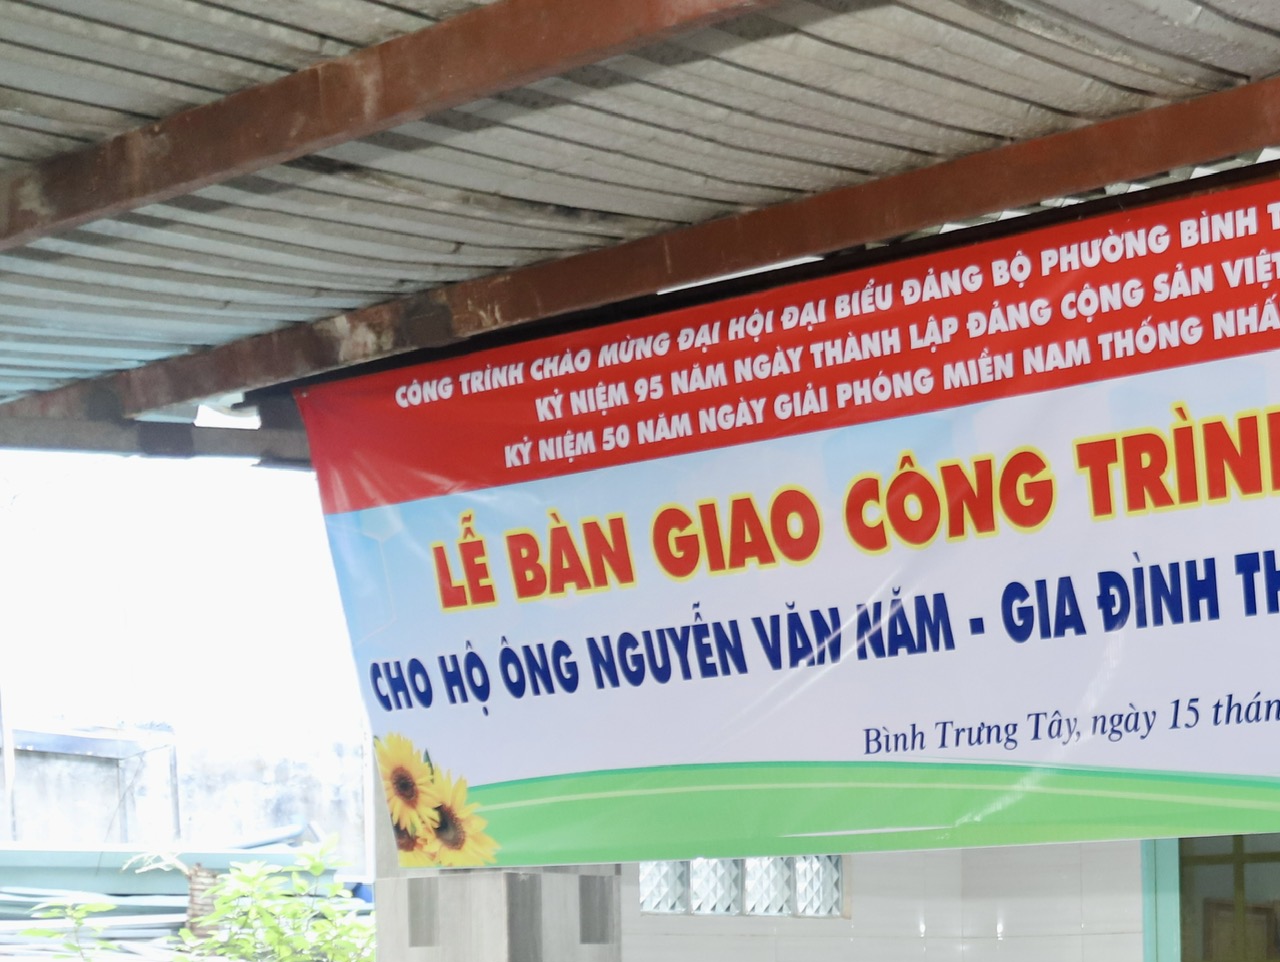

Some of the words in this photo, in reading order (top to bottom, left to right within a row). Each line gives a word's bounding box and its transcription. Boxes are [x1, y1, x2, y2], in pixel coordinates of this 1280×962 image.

[395, 377, 454, 408] CÔNG
[459, 363, 525, 395] TRÌNH
[530, 349, 592, 381] CHÀO
[597, 332, 670, 368] MỪNG
[677, 322, 720, 358] ĐẠI
[728, 310, 773, 343] HỘI
[781, 299, 827, 336] ĐẠI
[834, 278, 893, 319] BIỂU
[901, 265, 983, 306] ĐẢNG
[991, 250, 1032, 288] BỘ
[1040, 224, 1170, 277] PHƯỜNG
[1180, 204, 1258, 248] BÌNH
[535, 390, 564, 423] KỶ
[569, 380, 629, 416] NIỆM
[634, 375, 664, 401] 95
[670, 362, 727, 397] NĂM
[733, 343, 803, 383] NGÀY
[810, 326, 901, 368] THÀNH
[909, 316, 958, 355] LẬP
[966, 300, 1052, 339] ĐẢNG
[1061, 281, 1145, 323] CỘNG
[1153, 263, 1214, 303] SẢN
[504, 436, 532, 469] KỶ
[538, 427, 596, 463] NIỆM
[602, 426, 630, 452] 50
[637, 409, 692, 445] NĂM
[699, 393, 767, 432] NGÀY
[773, 380, 828, 422] GIẢI
[837, 364, 935, 409] PHÓNG
[943, 347, 1014, 390] MIỀN
[1022, 338, 1091, 376] NAM
[1098, 317, 1203, 361] THỐNG
[431, 513, 496, 610] LỄ
[505, 510, 635, 601] BÀN
[651, 488, 822, 580] GIAO
[844, 454, 1056, 553] CÔNG
[370, 657, 433, 712] CHO
[438, 640, 491, 717] HỘ
[499, 636, 580, 699] ÔNG
[590, 603, 748, 690] NGUYỄN
[752, 603, 842, 670] VĂN
[856, 586, 955, 660] NĂM
[1001, 575, 1087, 643] GIA
[1097, 551, 1220, 633] ĐÌNH
[863, 717, 926, 756] Bình
[935, 715, 1019, 750] Trưng
[1027, 707, 1082, 744] Tây,
[1091, 701, 1157, 741] ngày
[1168, 698, 1201, 731] 15
